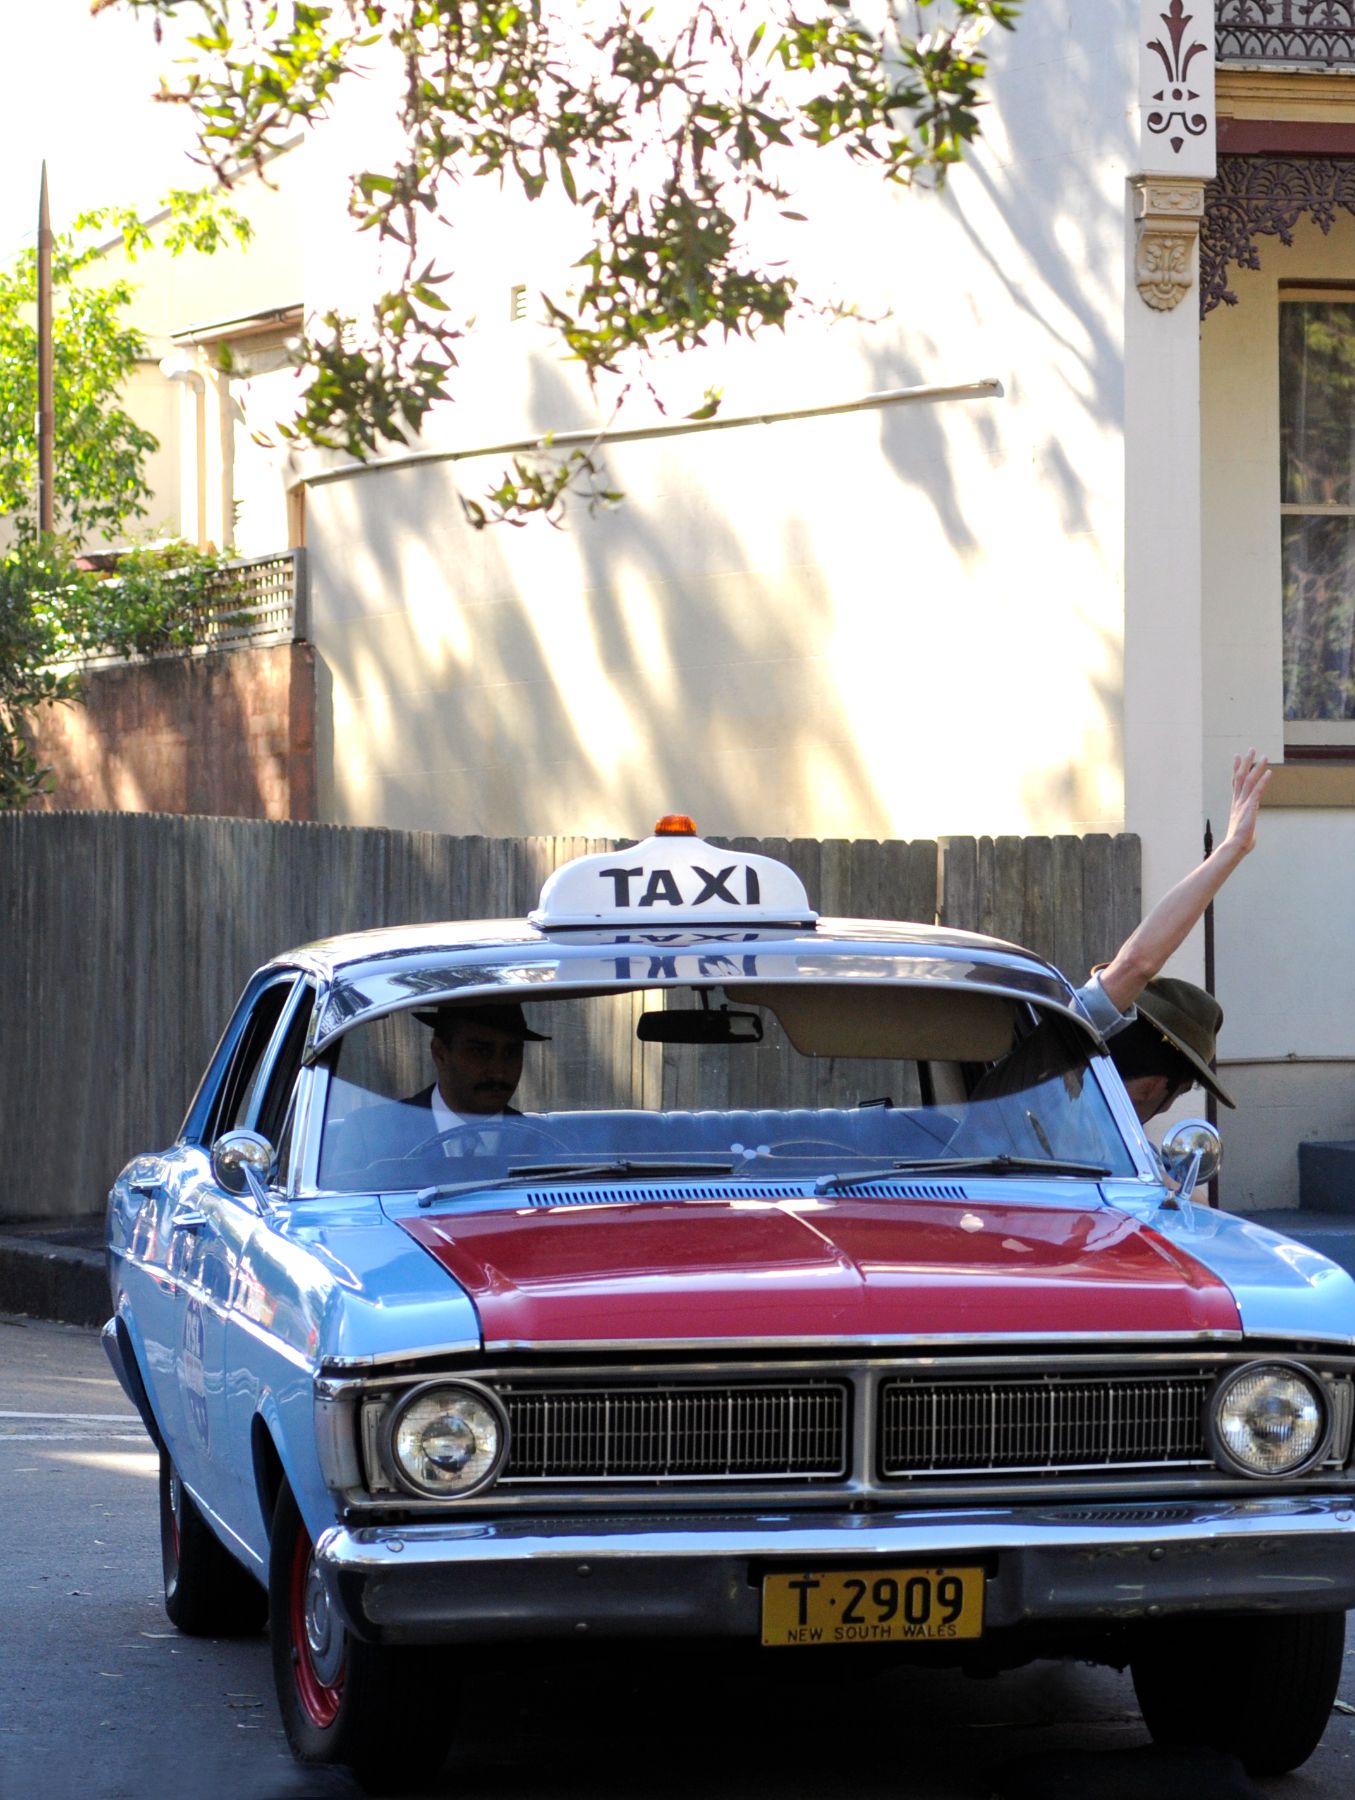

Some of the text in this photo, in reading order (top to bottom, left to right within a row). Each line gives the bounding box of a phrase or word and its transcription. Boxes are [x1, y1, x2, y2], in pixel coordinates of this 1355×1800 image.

[599, 864, 761, 908] TAXI
[788, 1624, 956, 1643] NEW SOUTH WALES
